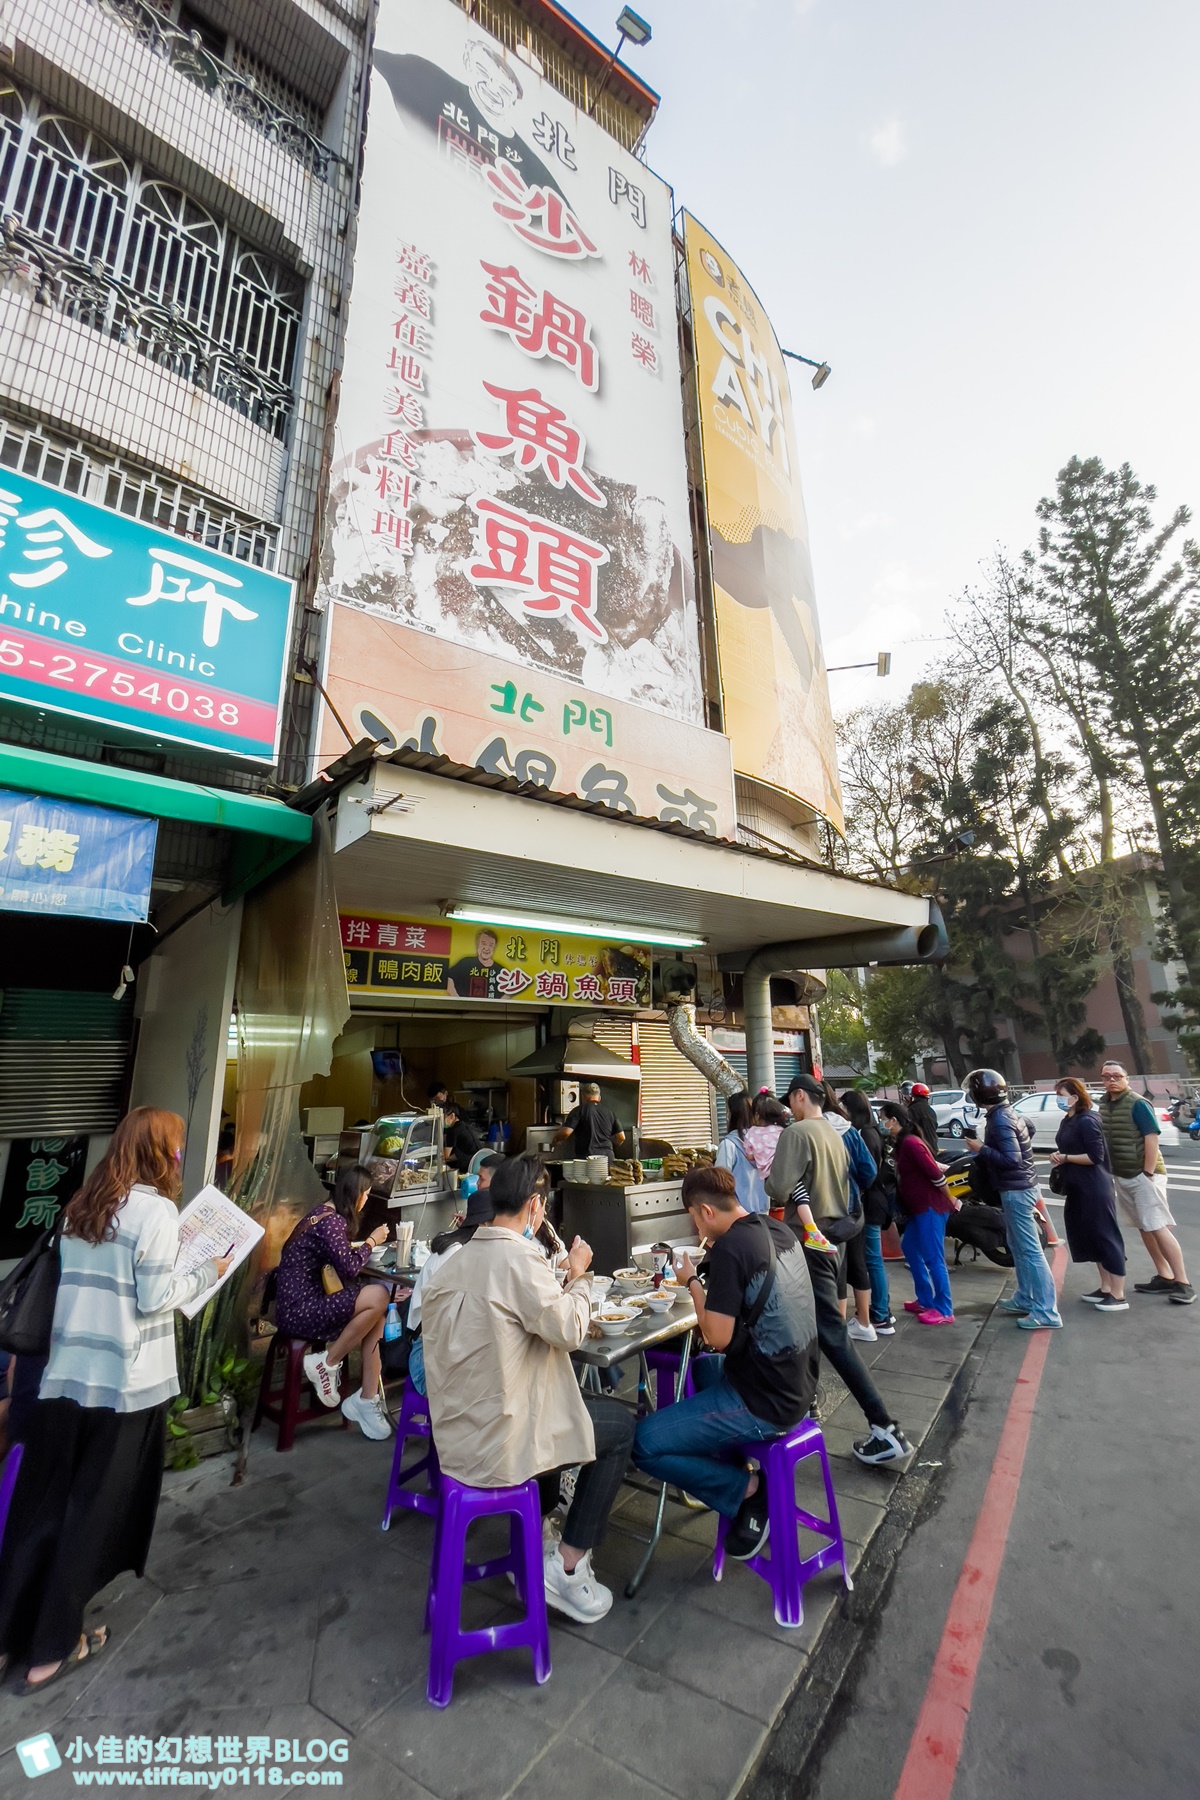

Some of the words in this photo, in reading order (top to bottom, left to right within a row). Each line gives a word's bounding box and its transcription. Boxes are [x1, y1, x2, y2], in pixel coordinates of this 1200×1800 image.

[532, 111, 648, 230] 北門
[371, 238, 432, 553] 嘉義在地美食料理
[468, 162, 604, 638] 沙鍋魚頭
[0, 487, 259, 648] 診所
[117, 632, 216, 677] Clinic
[490, 681, 613, 748] 北門
[346, 919, 427, 949] 拌青菜
[506, 935, 560, 965] 北門
[378, 958, 445, 984] 鴨肉飯
[469, 966, 490, 978] 北門
[496, 968, 638, 1004] 沙鍋魚頭
[315, 1361, 332, 1397] BOSTON
